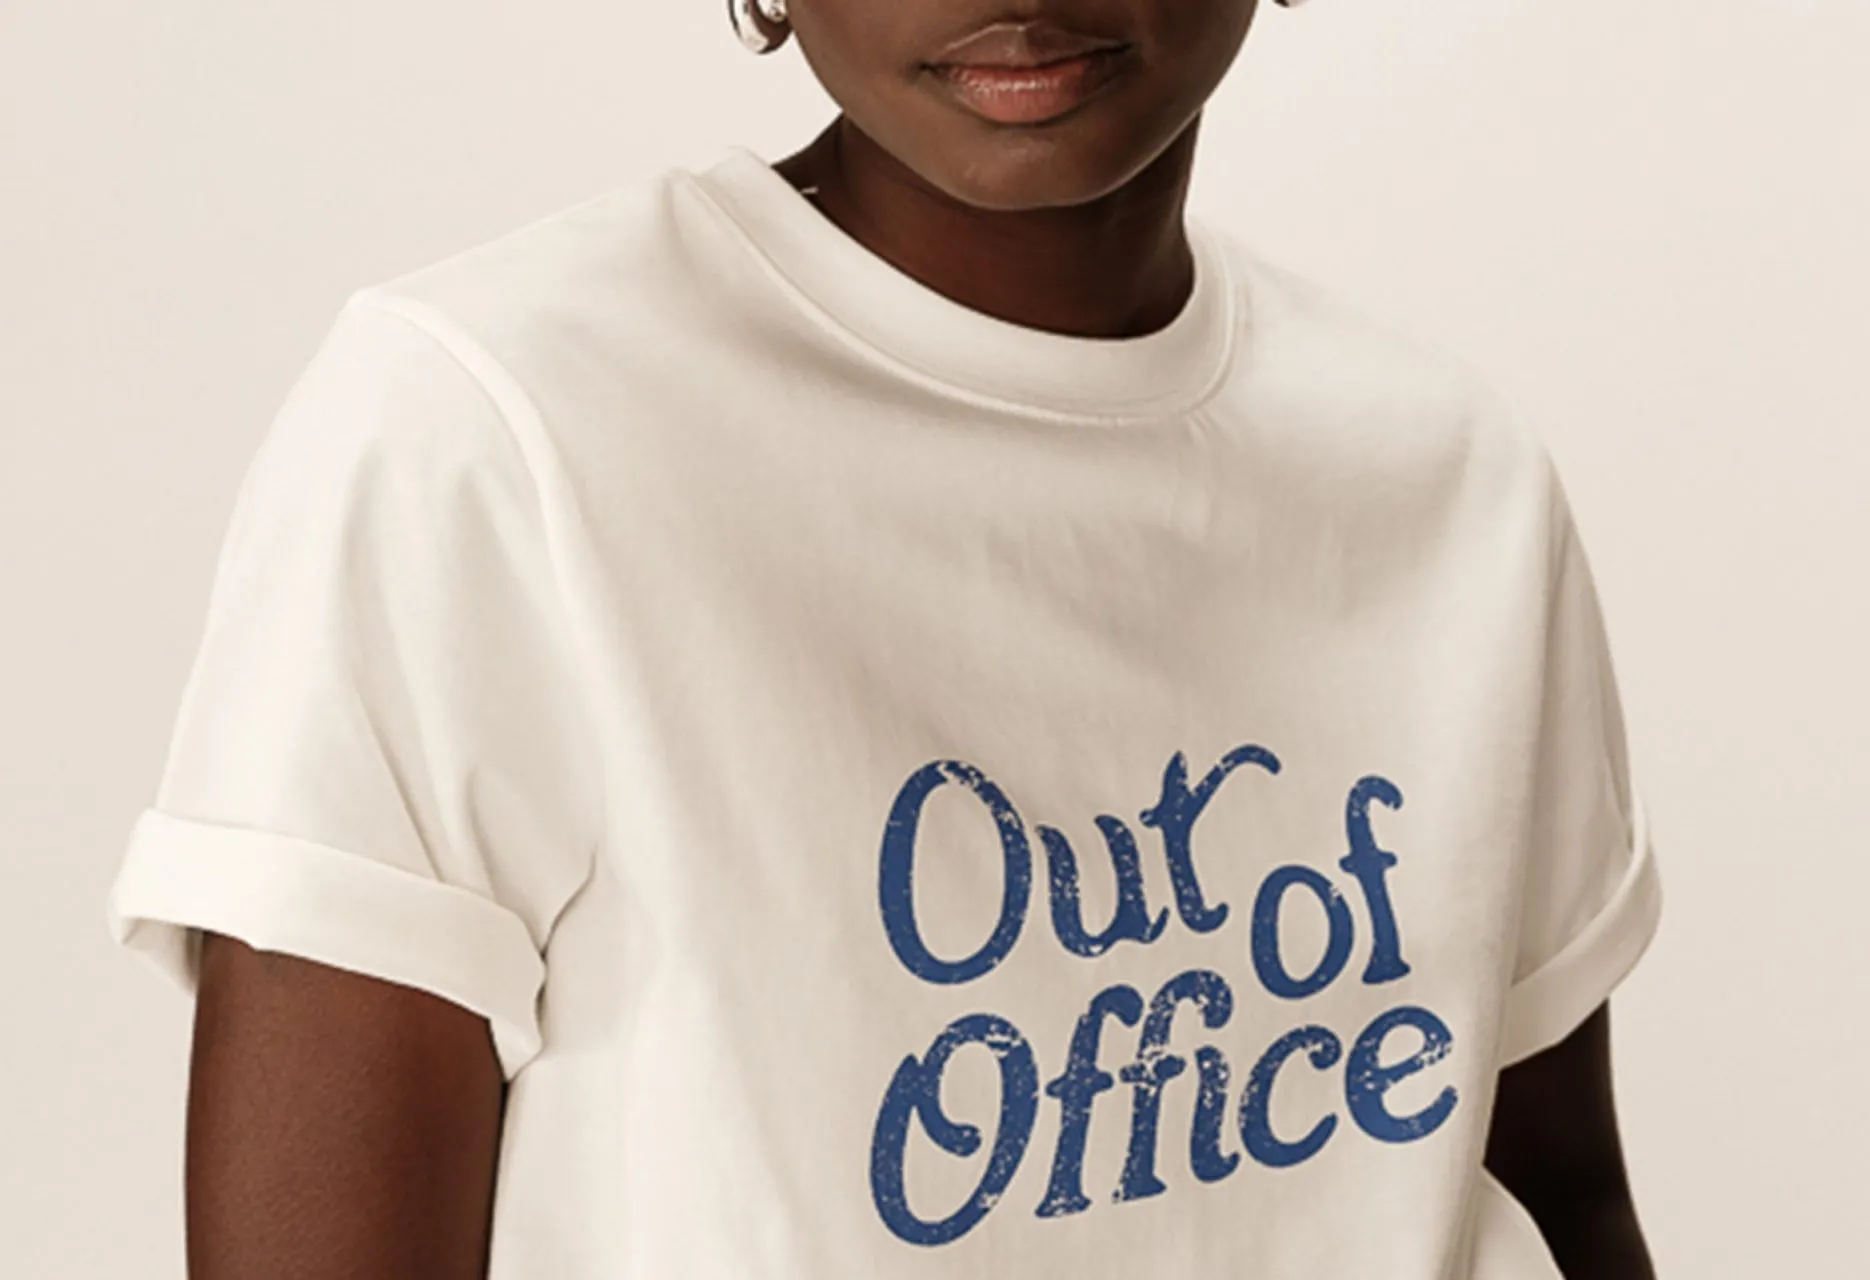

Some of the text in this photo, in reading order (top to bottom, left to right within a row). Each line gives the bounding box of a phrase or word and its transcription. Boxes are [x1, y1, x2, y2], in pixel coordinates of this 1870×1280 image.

[878, 746, 1410, 999] Out of
[870, 969, 1456, 1246] Office
